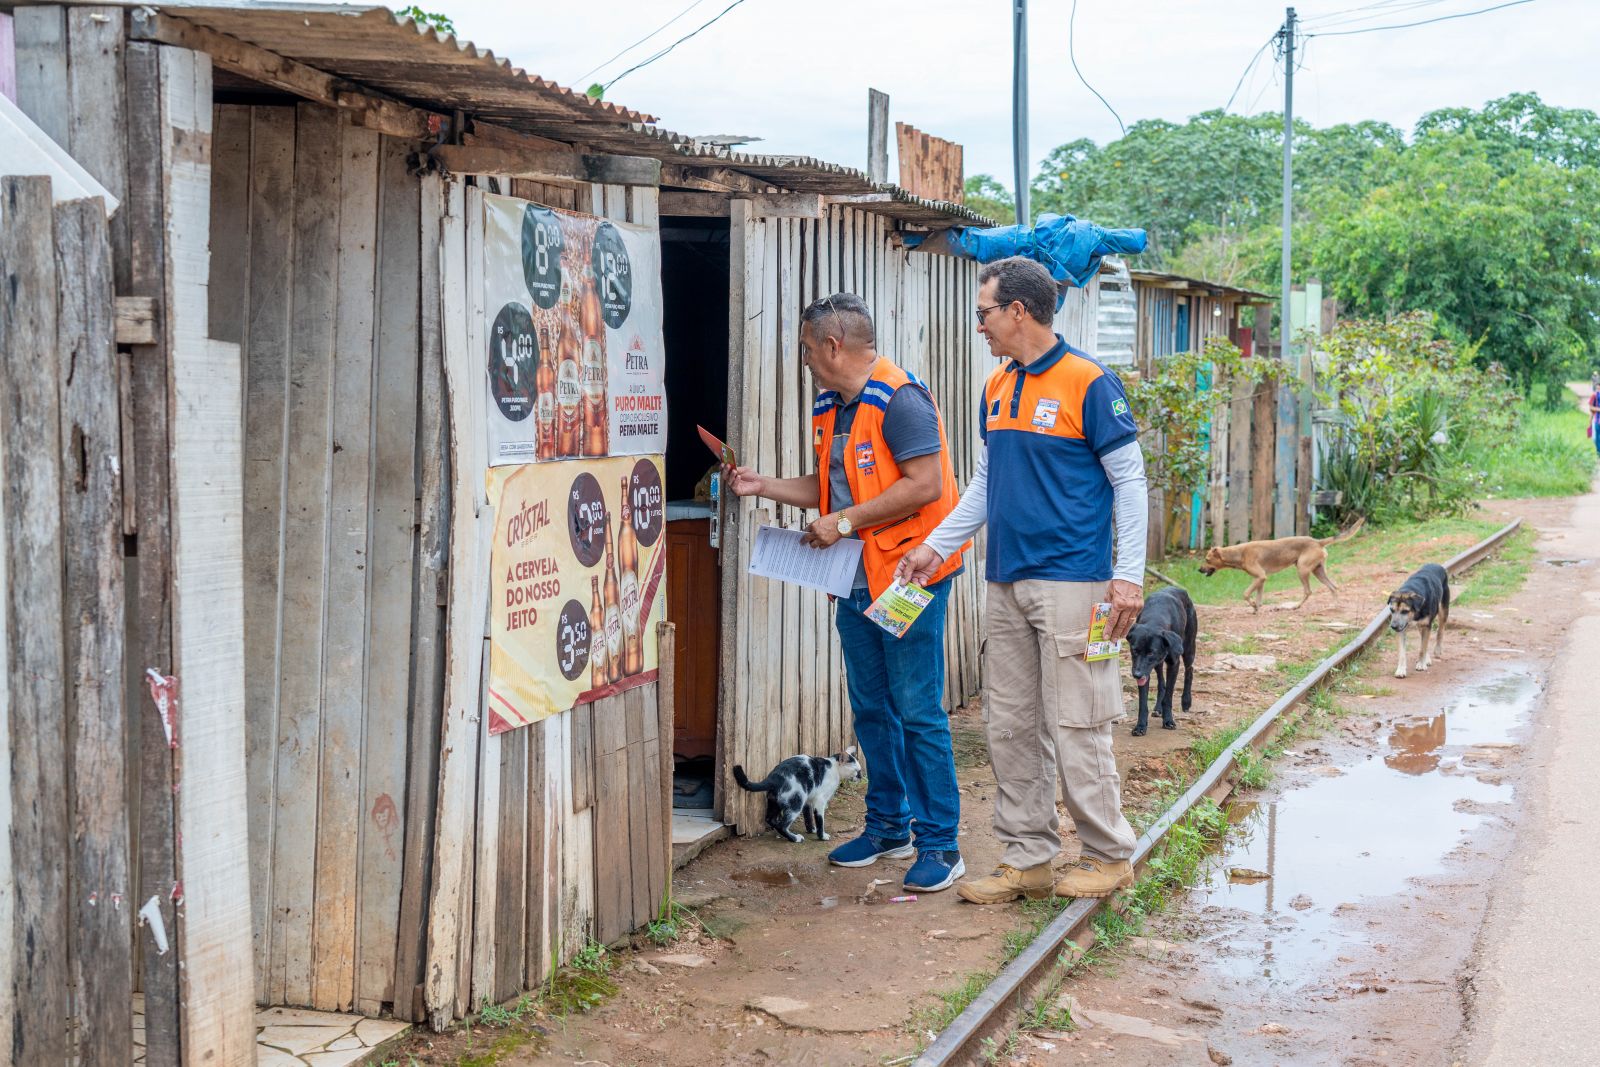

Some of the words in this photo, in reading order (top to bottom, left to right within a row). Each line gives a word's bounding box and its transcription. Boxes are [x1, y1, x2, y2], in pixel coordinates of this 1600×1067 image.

[625, 352, 648, 370] PETRA
[559, 380, 579, 395] PETRA
[615, 396, 636, 411] PURO
[637, 395, 662, 411] MALTE
[619, 424, 636, 437] PETRA
[637, 423, 659, 435] MALTE
[572, 490, 579, 500] R$
[633, 485, 661, 530] 10,00
[507, 498, 550, 547] CRYSTAL
[506, 565, 514, 583] A
[515, 557, 559, 581] CERVEJA
[506, 587, 524, 607] DO
[525, 578, 560, 603] NOSSO
[506, 607, 537, 632] JEITO
[561, 621, 587, 672] 3,50
